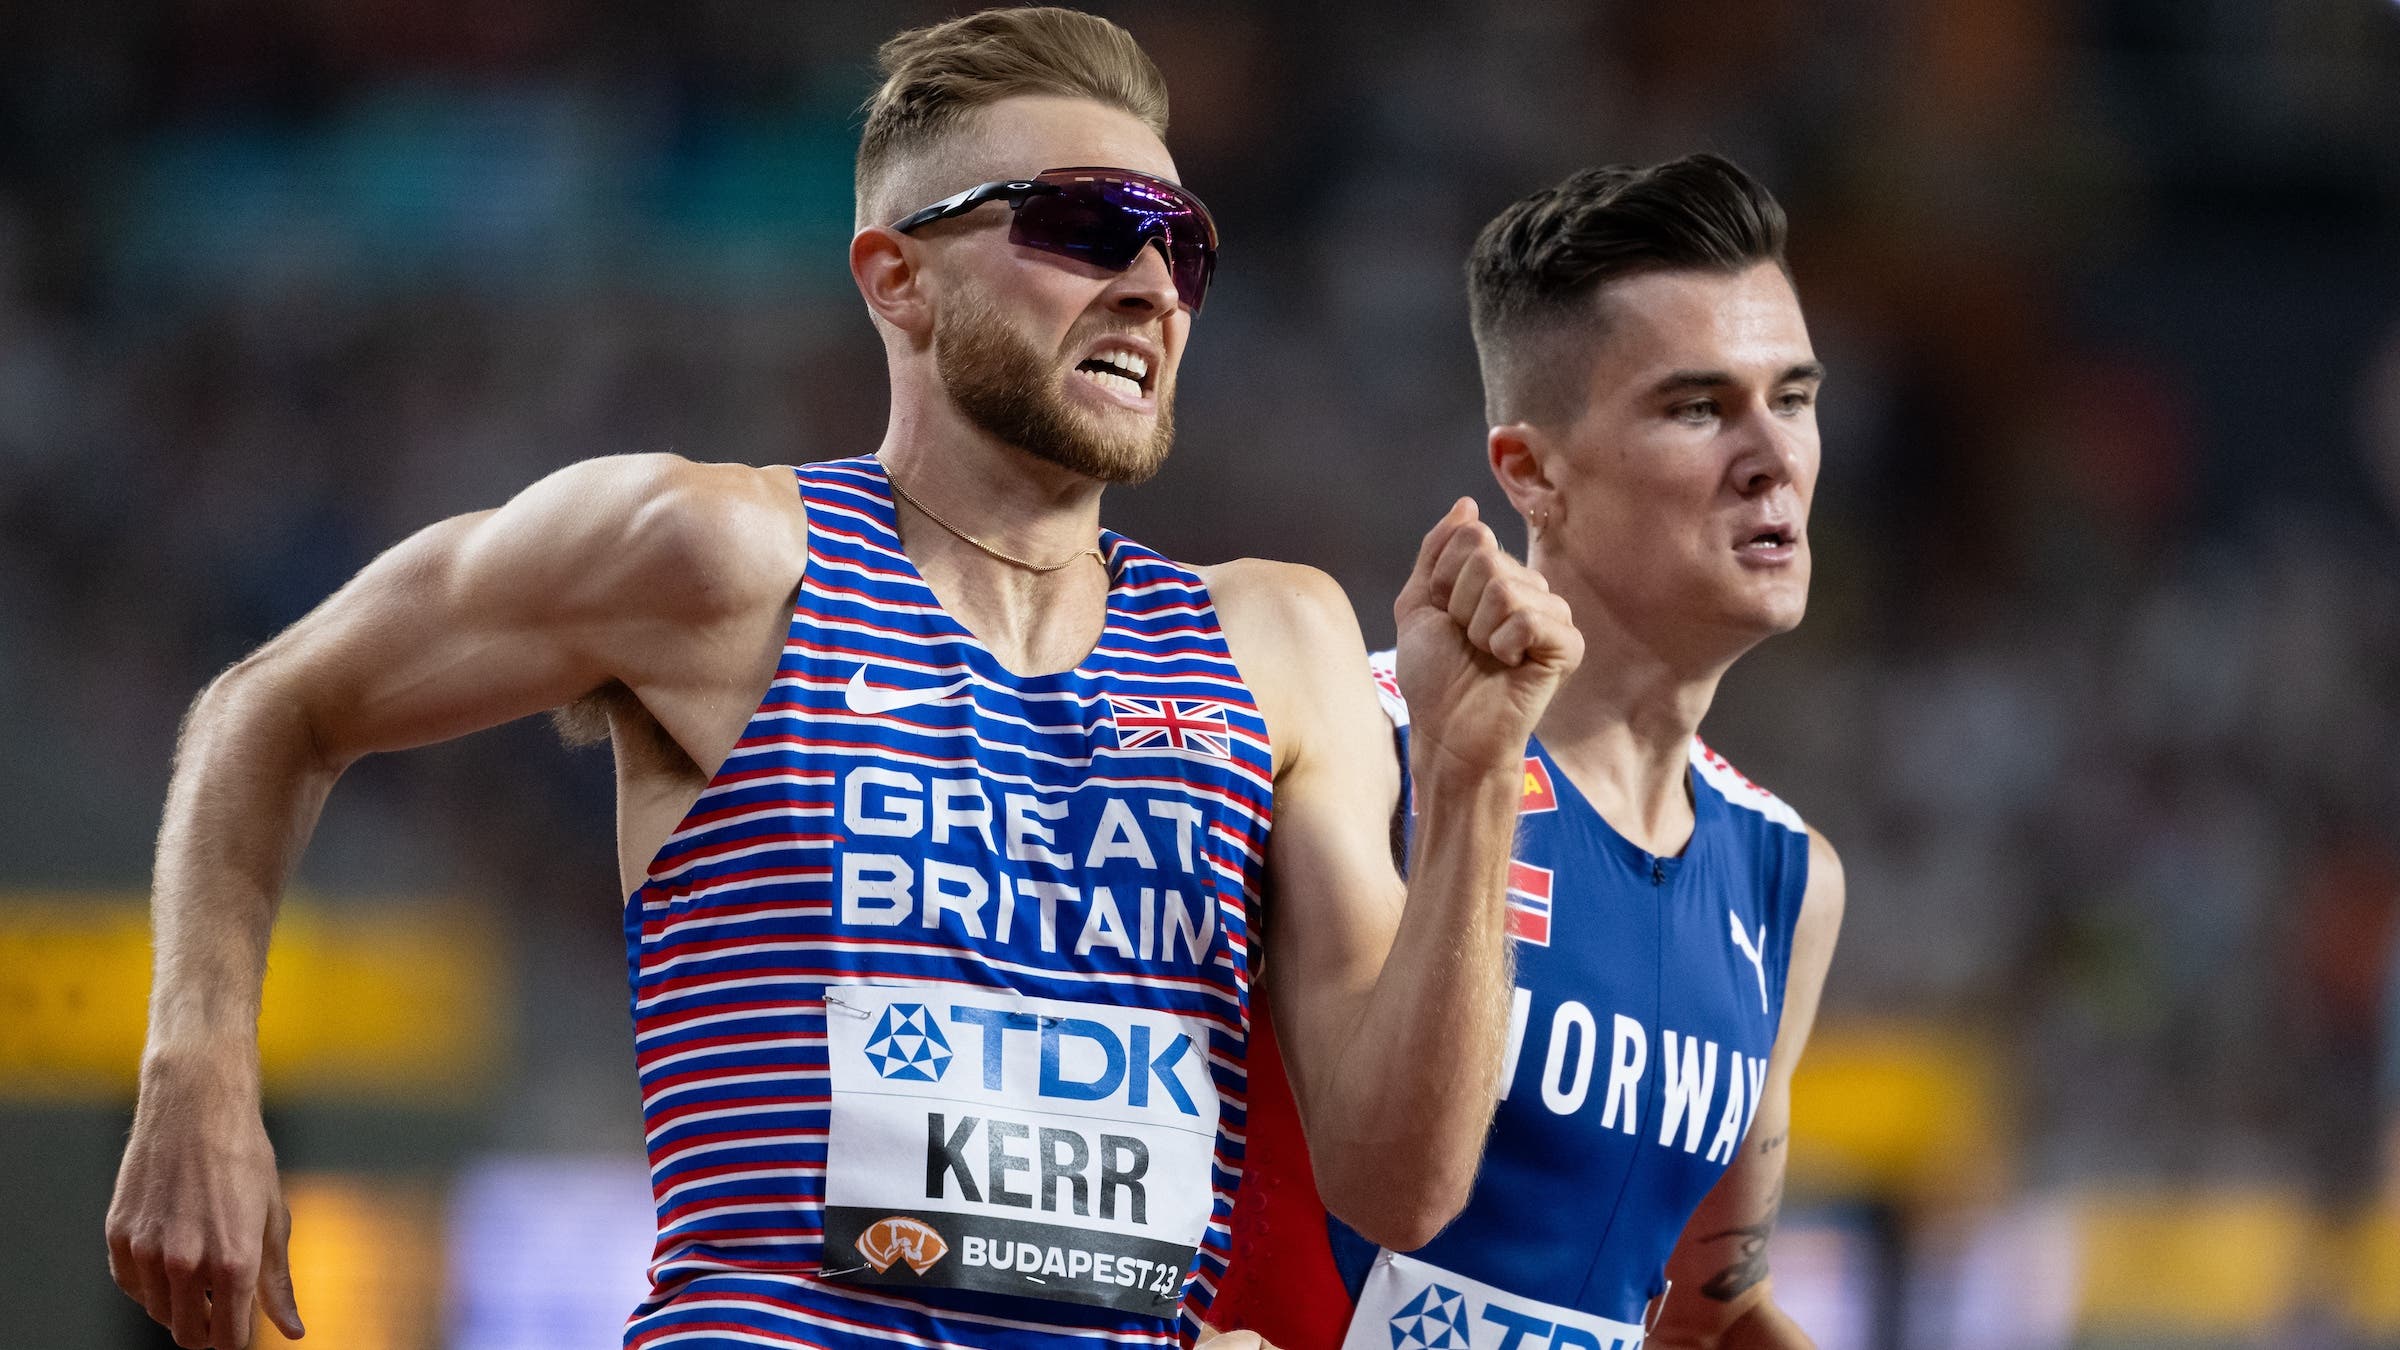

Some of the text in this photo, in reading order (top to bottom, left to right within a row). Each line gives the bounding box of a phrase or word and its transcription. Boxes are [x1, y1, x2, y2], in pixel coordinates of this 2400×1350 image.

[843, 766, 1202, 874] GREAT
[841, 852, 1215, 966] BRITAIN
[950, 1004, 1200, 1117] TDK
[926, 1112, 1150, 1225] KERR
